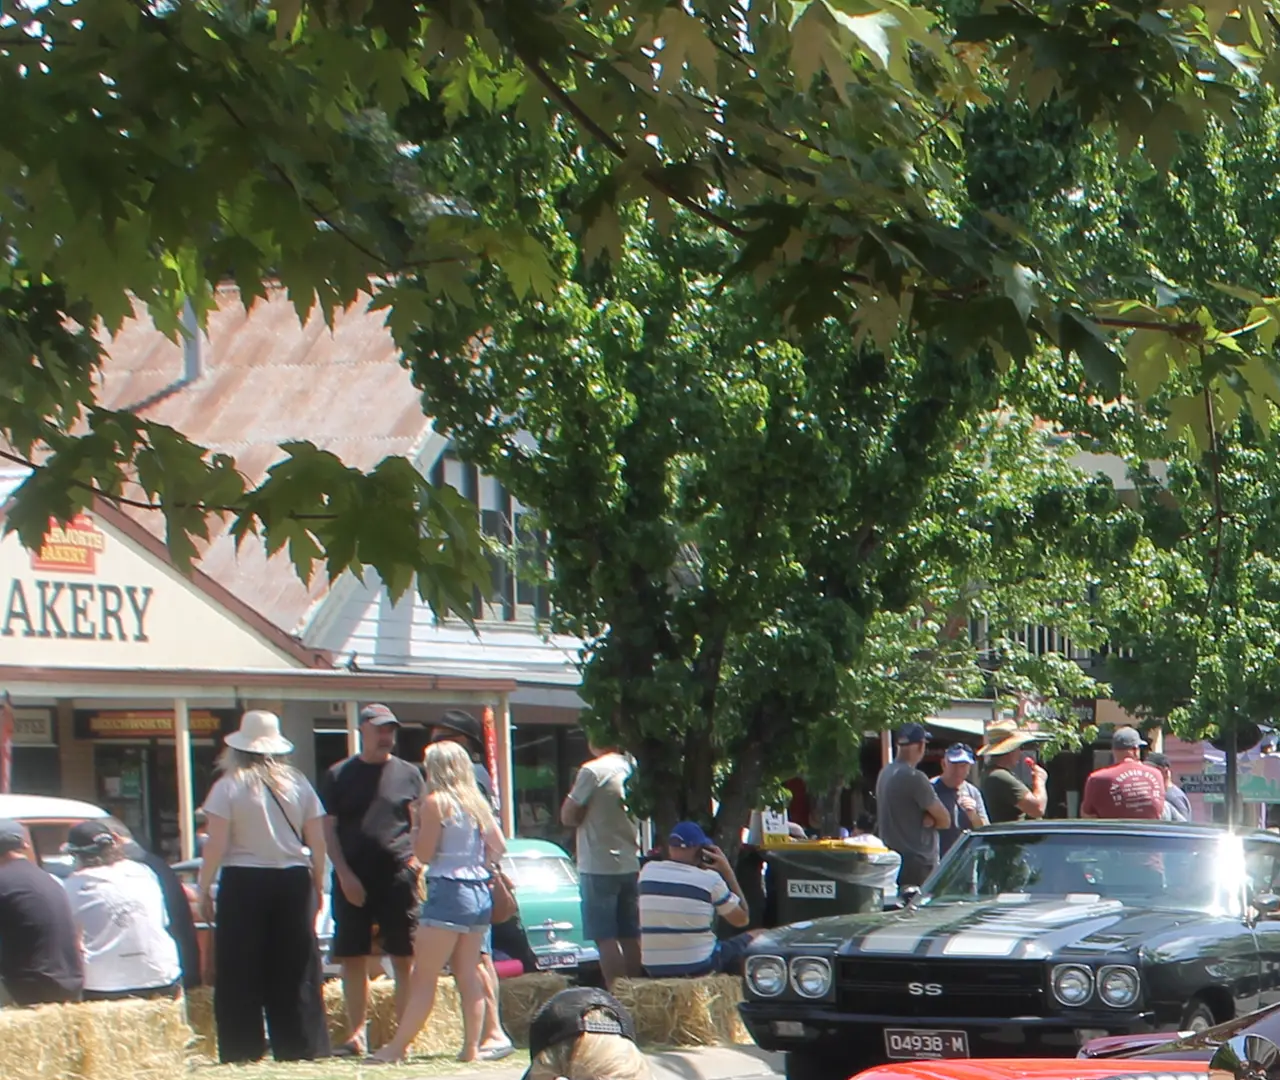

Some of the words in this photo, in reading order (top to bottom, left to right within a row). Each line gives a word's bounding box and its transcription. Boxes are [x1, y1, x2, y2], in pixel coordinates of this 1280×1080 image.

[1, 578, 153, 642] AKERY
[790, 883, 833, 894] EVENTS
[908, 982, 943, 996] SS
